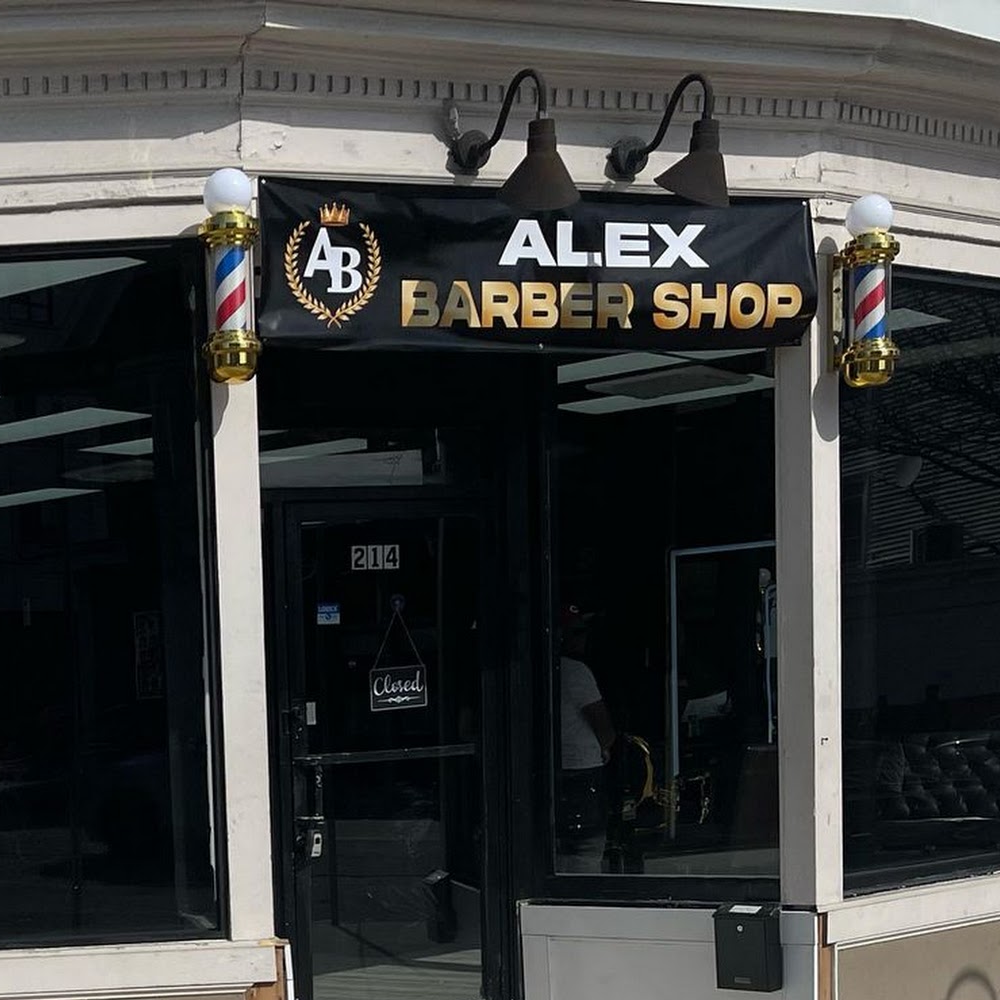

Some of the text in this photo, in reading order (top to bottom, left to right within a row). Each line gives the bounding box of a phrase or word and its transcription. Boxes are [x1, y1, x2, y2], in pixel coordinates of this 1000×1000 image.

[303, 226, 364, 294] AB
[499, 219, 710, 268] ALEX
[401, 279, 803, 330] BARBER SHOP
[353, 546, 399, 568] 214
[373, 670, 424, 696] Closed
